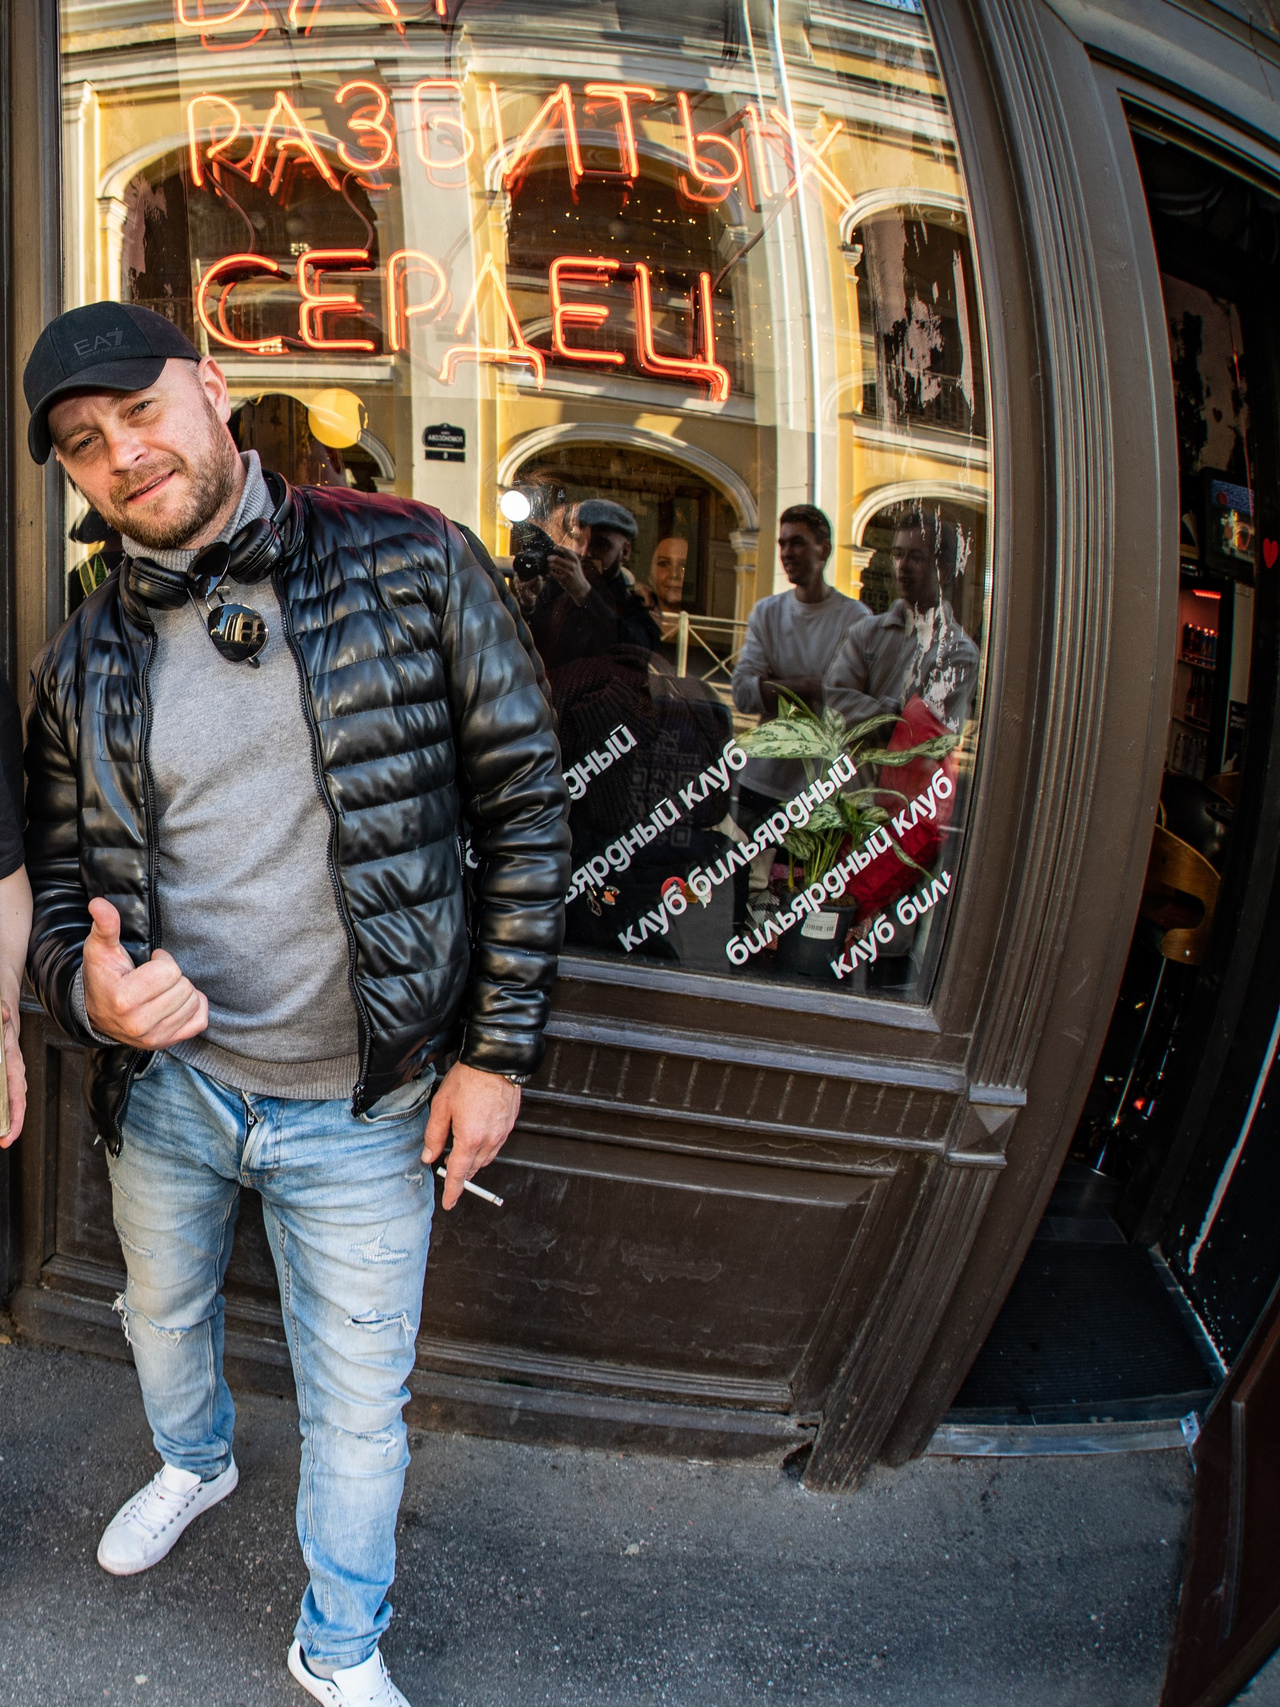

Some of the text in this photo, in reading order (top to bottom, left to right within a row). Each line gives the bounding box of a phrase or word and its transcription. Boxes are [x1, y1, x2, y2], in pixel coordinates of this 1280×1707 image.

[186, 78, 856, 211] РАЗБИТЫХ
[73, 329, 124, 356] EA7
[196, 248, 730, 402] СЕРДЕЦ
[677, 738, 748, 810] клуб
[618, 752, 858, 952] клуб бильярдный
[725, 767, 953, 965] бильярдный клуб
[829, 913, 896, 980] клуб
